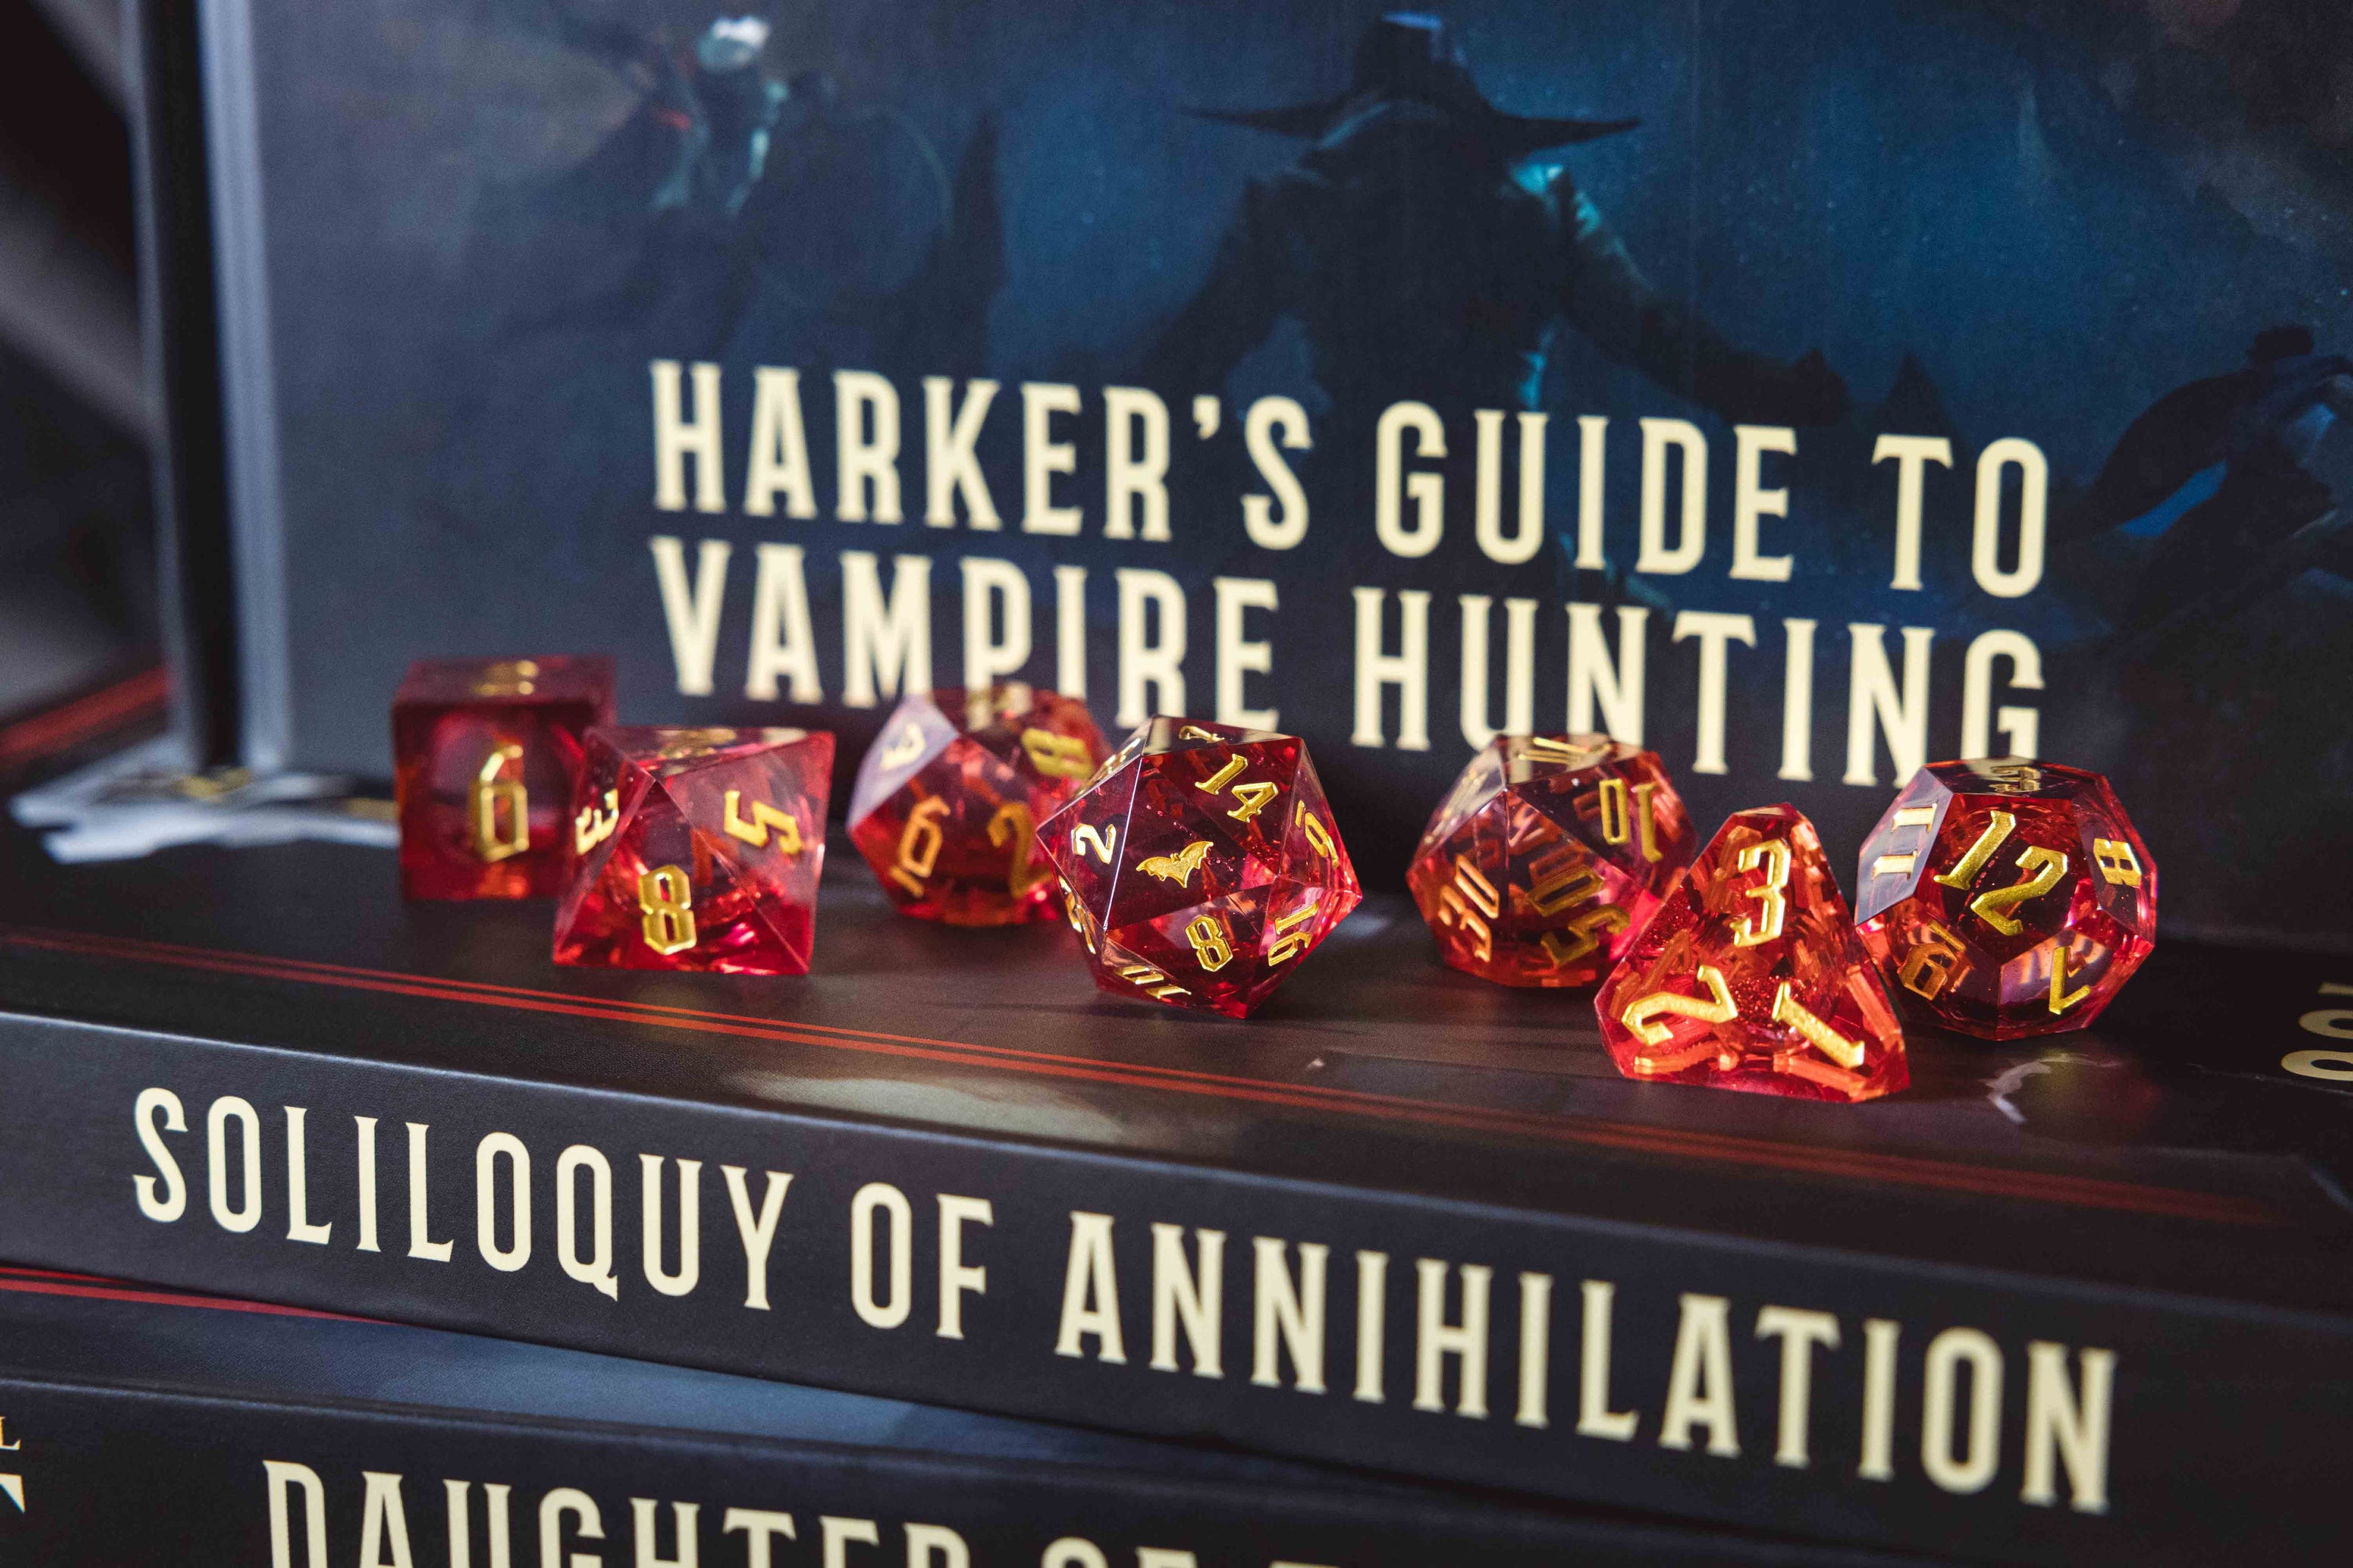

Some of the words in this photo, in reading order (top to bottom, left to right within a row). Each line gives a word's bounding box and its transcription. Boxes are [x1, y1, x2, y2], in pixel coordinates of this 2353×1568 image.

[651, 359, 1313, 550] HARKER'S
[1375, 401, 1797, 582] GUIDE
[1871, 433, 2049, 598] TO
[650, 536, 1279, 734] VAMPIRE
[1350, 586, 2046, 788] HUNTING
[476, 742, 530, 862] 6
[1195, 753, 1279, 823] 14
[1071, 822, 1117, 864] 2
[1871, 802, 1938, 882] 11
[1933, 809, 2068, 937] 12
[2093, 837, 2142, 888] 8
[638, 864, 697, 956] 8
[1438, 854, 1500, 964] 30
[1729, 839, 1792, 948] 3
[1185, 915, 1234, 973] 8
[1621, 965, 1739, 1046] 2
[1772, 981, 1865, 1069] 1
[133, 1086, 794, 1311] SOLILOQUY
[850, 1182, 993, 1340] OF
[1054, 1210, 2118, 1514] ANNIHILATION
